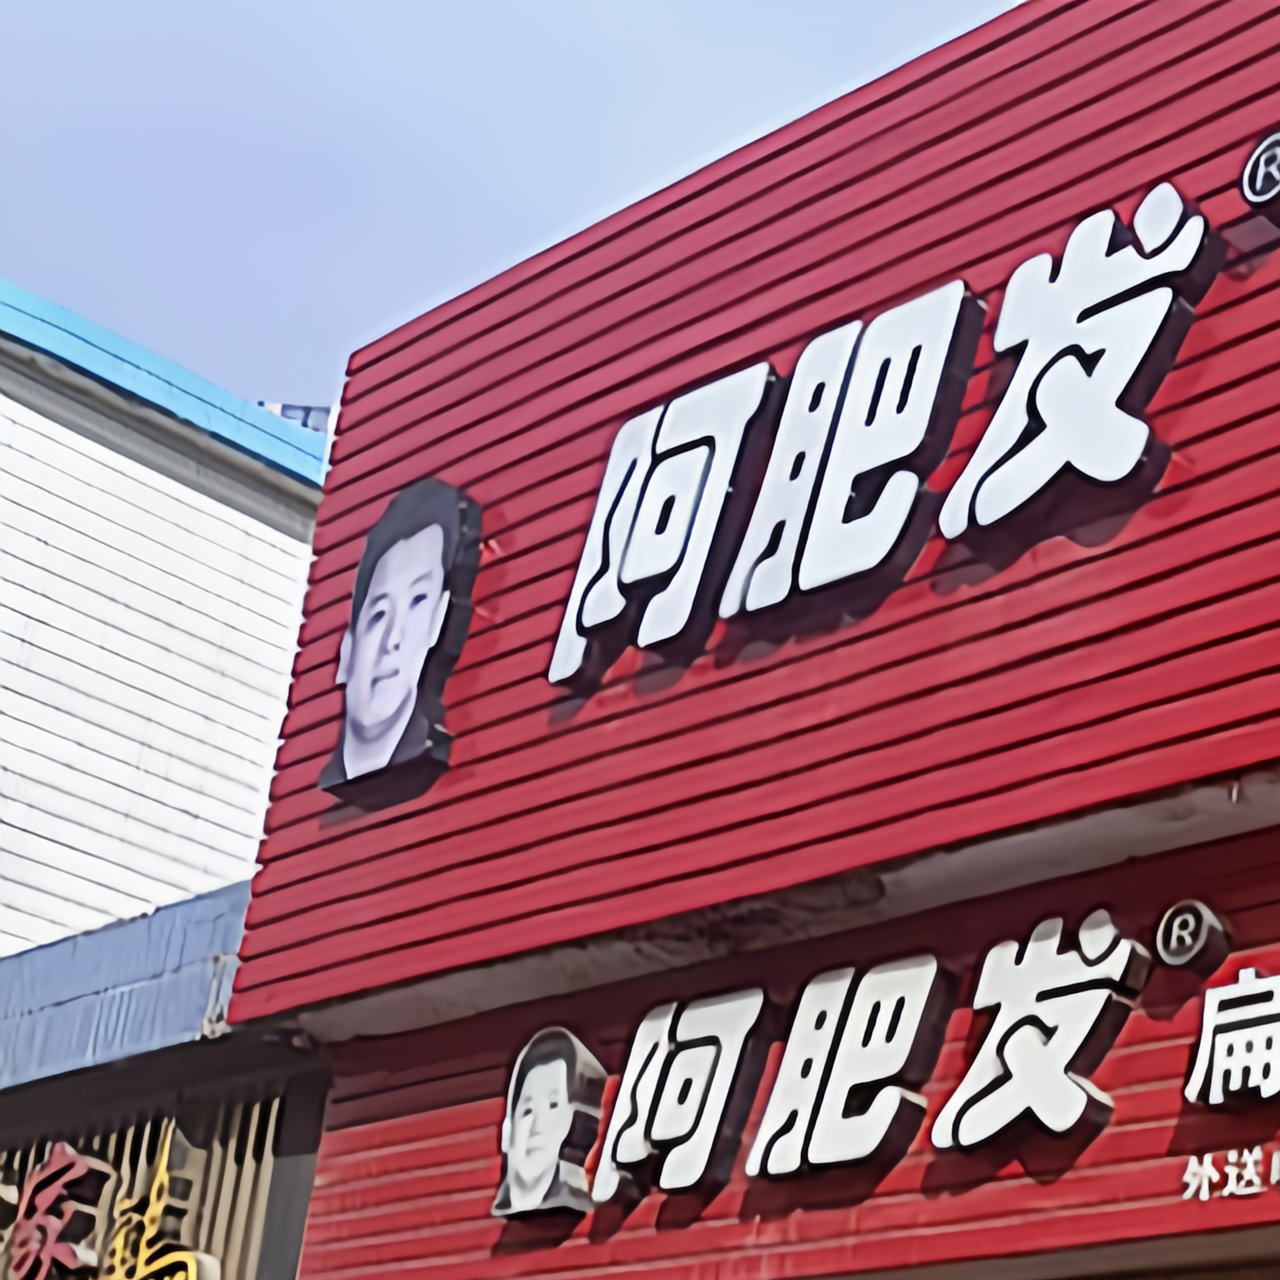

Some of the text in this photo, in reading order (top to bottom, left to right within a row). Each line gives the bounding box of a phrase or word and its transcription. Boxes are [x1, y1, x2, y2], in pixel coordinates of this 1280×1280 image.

[548, 182, 1205, 682] 阿肥发
[592, 909, 1133, 1203] 阿肥发
